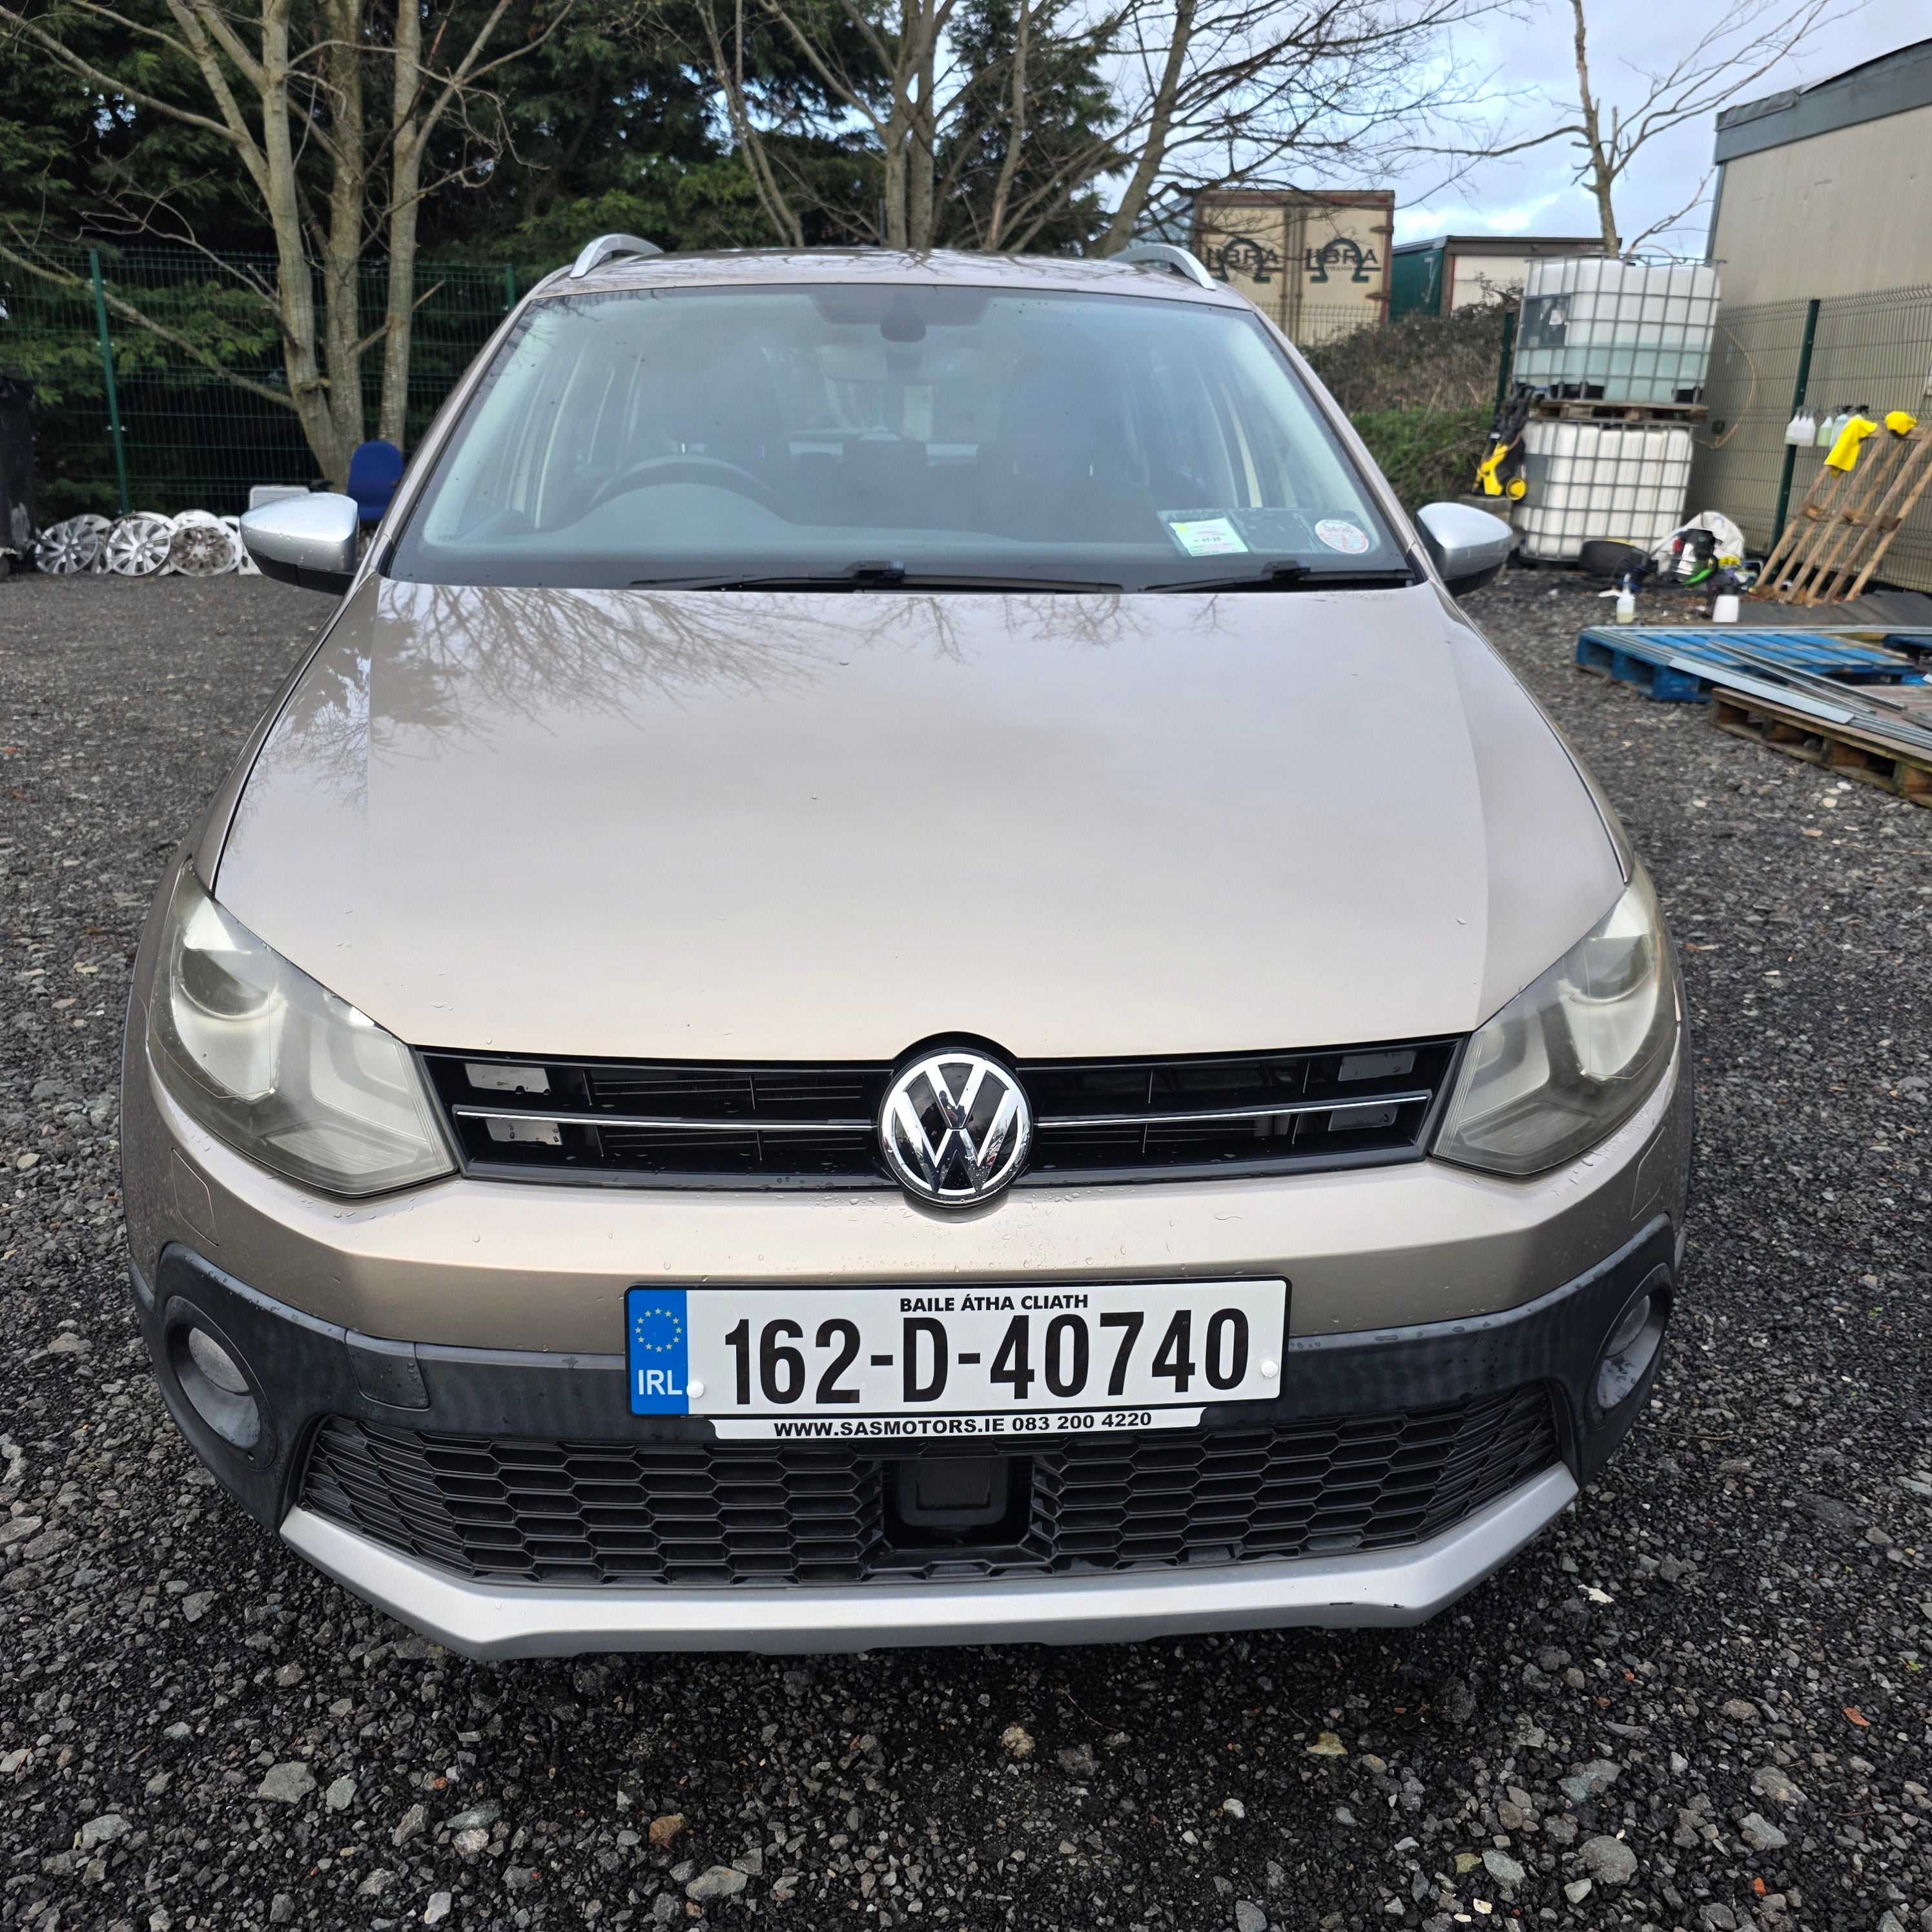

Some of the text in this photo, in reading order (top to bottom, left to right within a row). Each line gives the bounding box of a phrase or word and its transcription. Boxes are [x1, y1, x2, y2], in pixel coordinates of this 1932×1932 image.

[1305, 249, 1381, 271] LIBRA
[900, 1293, 1088, 1312] BAILE ÁTHA CLIATH
[725, 1308, 1249, 1405] 162-D-40740
[638, 1369, 683, 1395] IRL
[774, 1412, 1151, 1437] WWW.SASMOTORS.IE 083 200 4220
